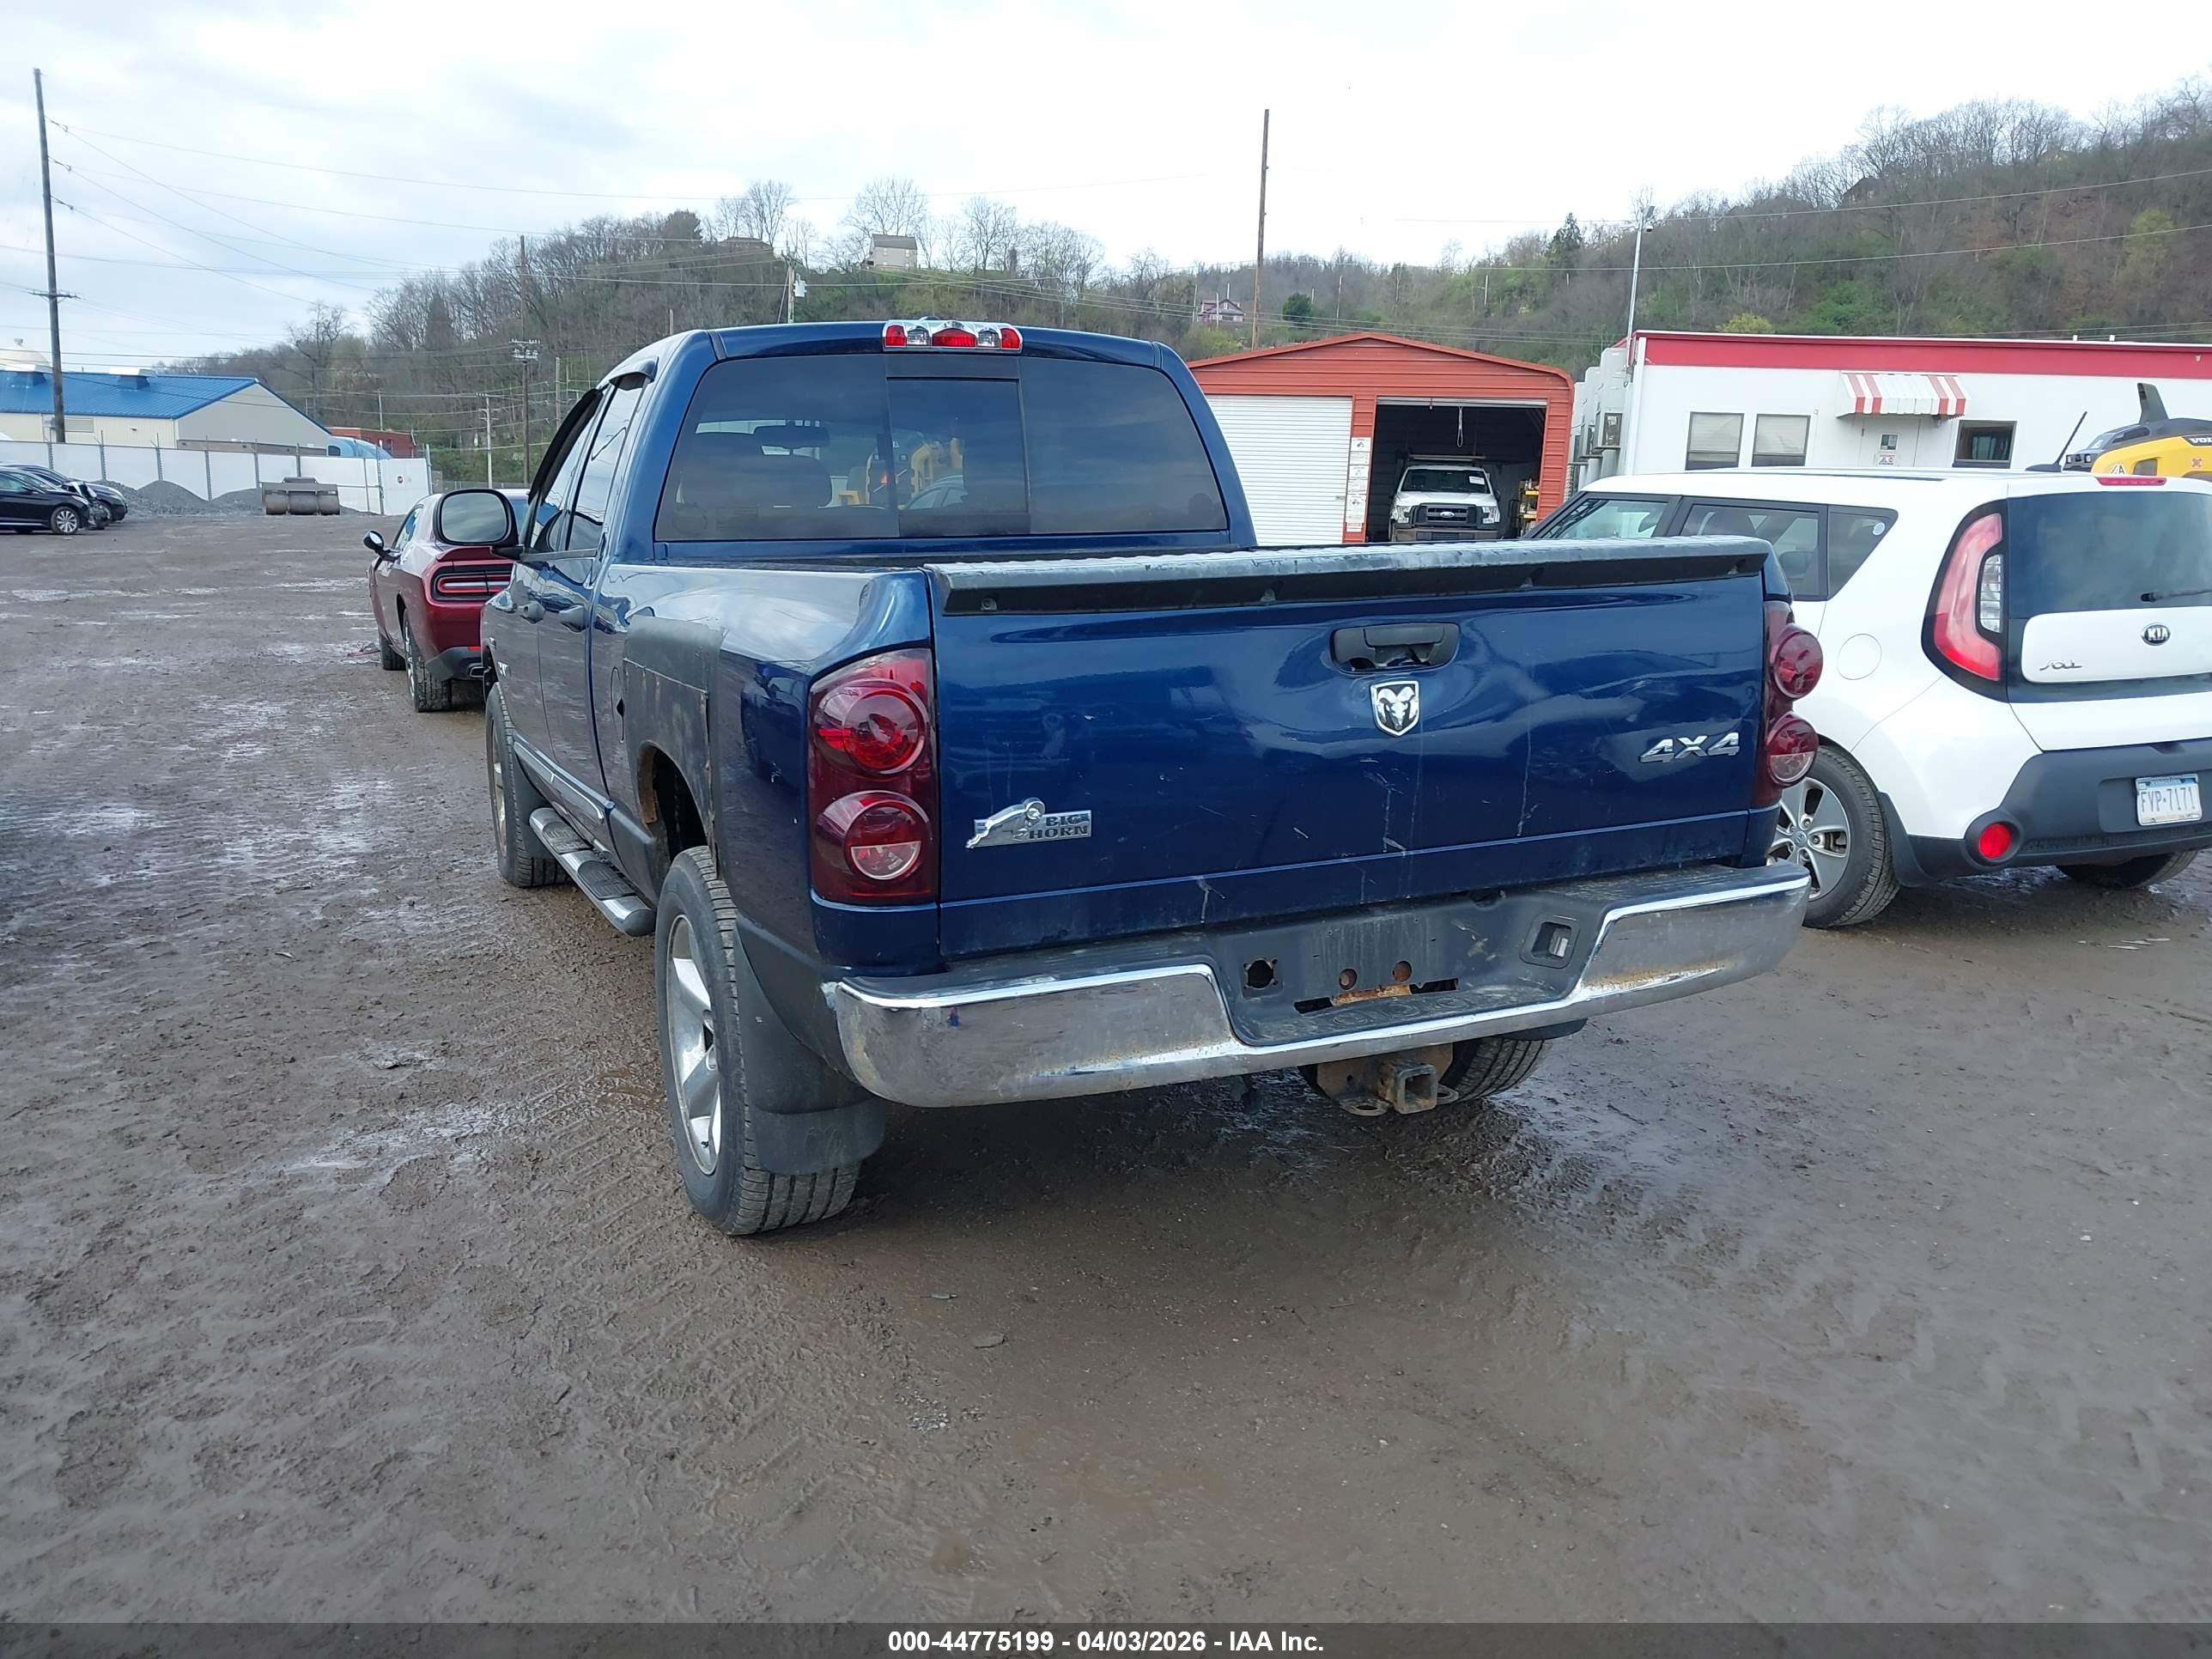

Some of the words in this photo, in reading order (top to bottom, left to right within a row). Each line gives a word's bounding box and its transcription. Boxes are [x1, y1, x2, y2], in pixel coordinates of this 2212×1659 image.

[2147, 627, 2169, 641] KIA
[1045, 813, 1091, 827] BIG
[1029, 825, 1088, 839] HORN
